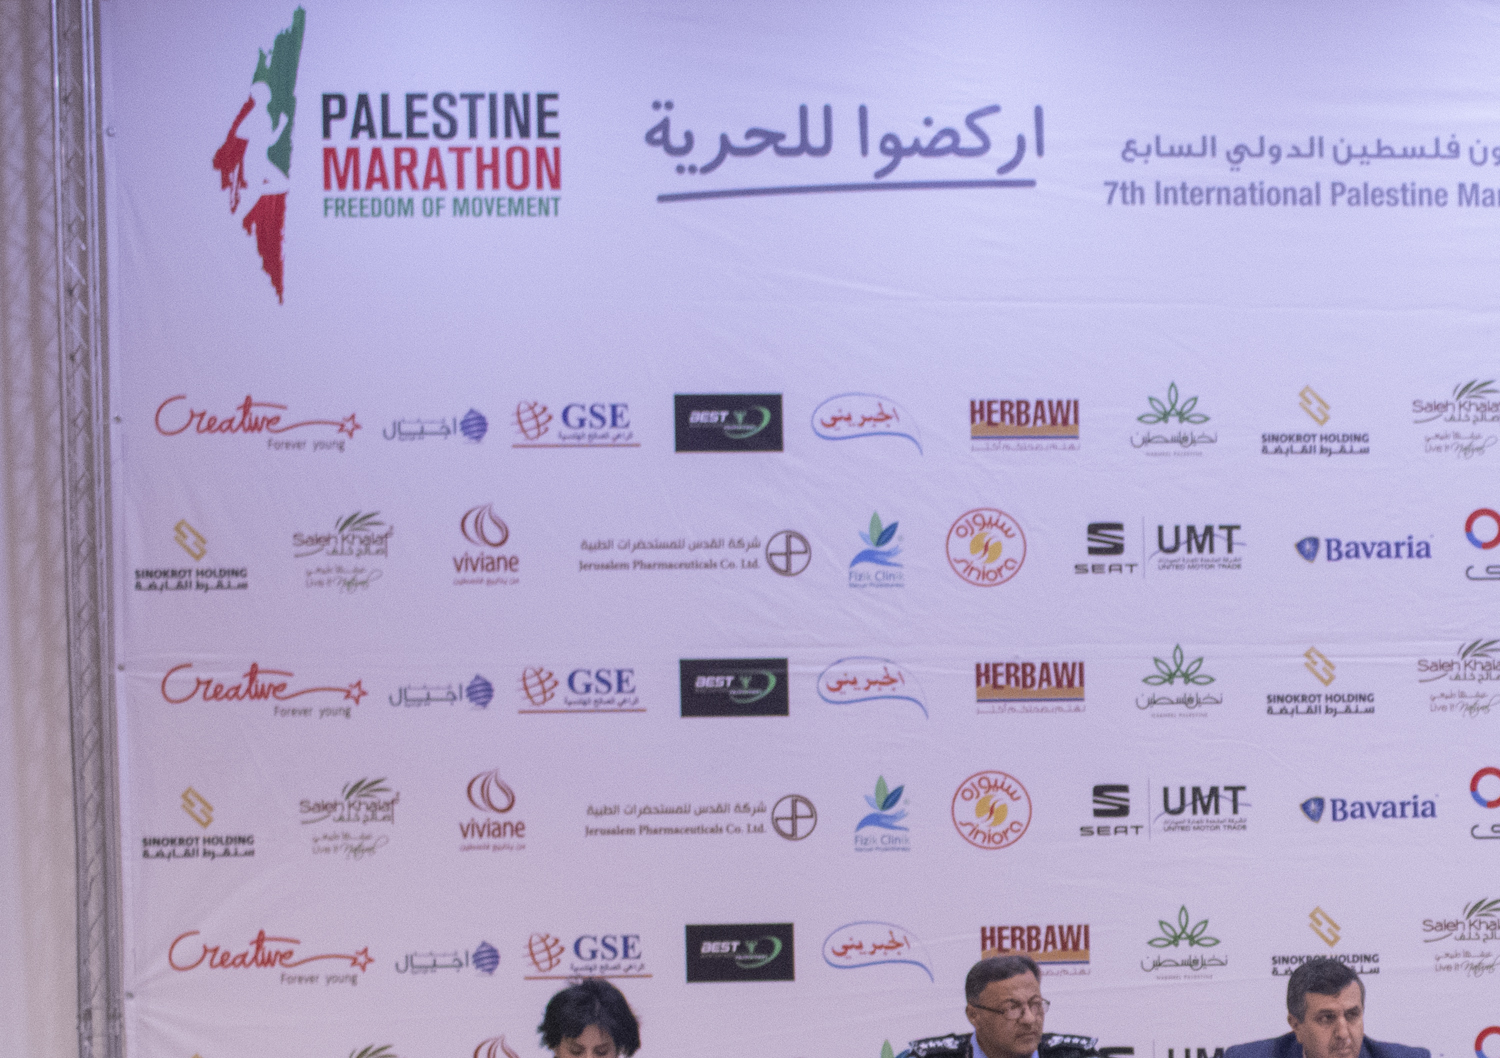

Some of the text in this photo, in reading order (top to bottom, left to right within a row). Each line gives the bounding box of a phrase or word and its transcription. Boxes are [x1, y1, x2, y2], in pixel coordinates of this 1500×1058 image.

[321, 92, 559, 140] PALESTINE
[643, 100, 1046, 181] اركضوا للحرية
[1120, 135, 1217, 163] السابع
[1225, 135, 1325, 171] الدولي
[1333, 135, 1461, 166] فلسطين
[322, 146, 561, 191] MARATHON
[323, 197, 561, 218] FREEDOM OF MOVEMENT
[1103, 180, 1146, 208] 7th
[1155, 181, 1322, 208] International
[1330, 181, 1449, 209] Palestine
[155, 394, 287, 436] Creative
[562, 402, 631, 430] GSE
[690, 409, 729, 424] BEST
[970, 399, 1079, 427] HERBAWI
[267, 438, 345, 452] Forever young
[1262, 433, 1369, 443] SINOKROT HOLDING
[1158, 525, 1241, 554] UMT
[1325, 535, 1432, 561] Bavaria
[135, 568, 247, 578] SINOKROT HOLDING
[453, 553, 519, 573] viviane
[1075, 563, 1138, 574] SEAT
[162, 661, 294, 703] Creative
[568, 667, 637, 695] GSE
[696, 674, 735, 689] BEST
[975, 662, 1084, 690] HERBAWI
[1267, 693, 1374, 703] SINOKROT HOLDING
[273, 705, 351, 719] Forever young
[695, 802, 732, 815] القدس
[735, 802, 767, 815] شركة
[1163, 786, 1246, 815] UMT
[1330, 795, 1437, 821] Bavaria
[142, 835, 254, 846] SINOKROT HOLDING
[459, 819, 525, 839] viviane
[585, 825, 635, 837] Jerusalem
[639, 824, 723, 836] Pharmaceuticals
[1080, 825, 1143, 836] SEAT
[1423, 919, 1464, 932] Saleh
[169, 928, 301, 970] Creative
[574, 933, 643, 961] GSE
[702, 939, 741, 954] BEST
[980, 925, 1089, 953] HERBAWI
[280, 972, 357, 986] Forever young
